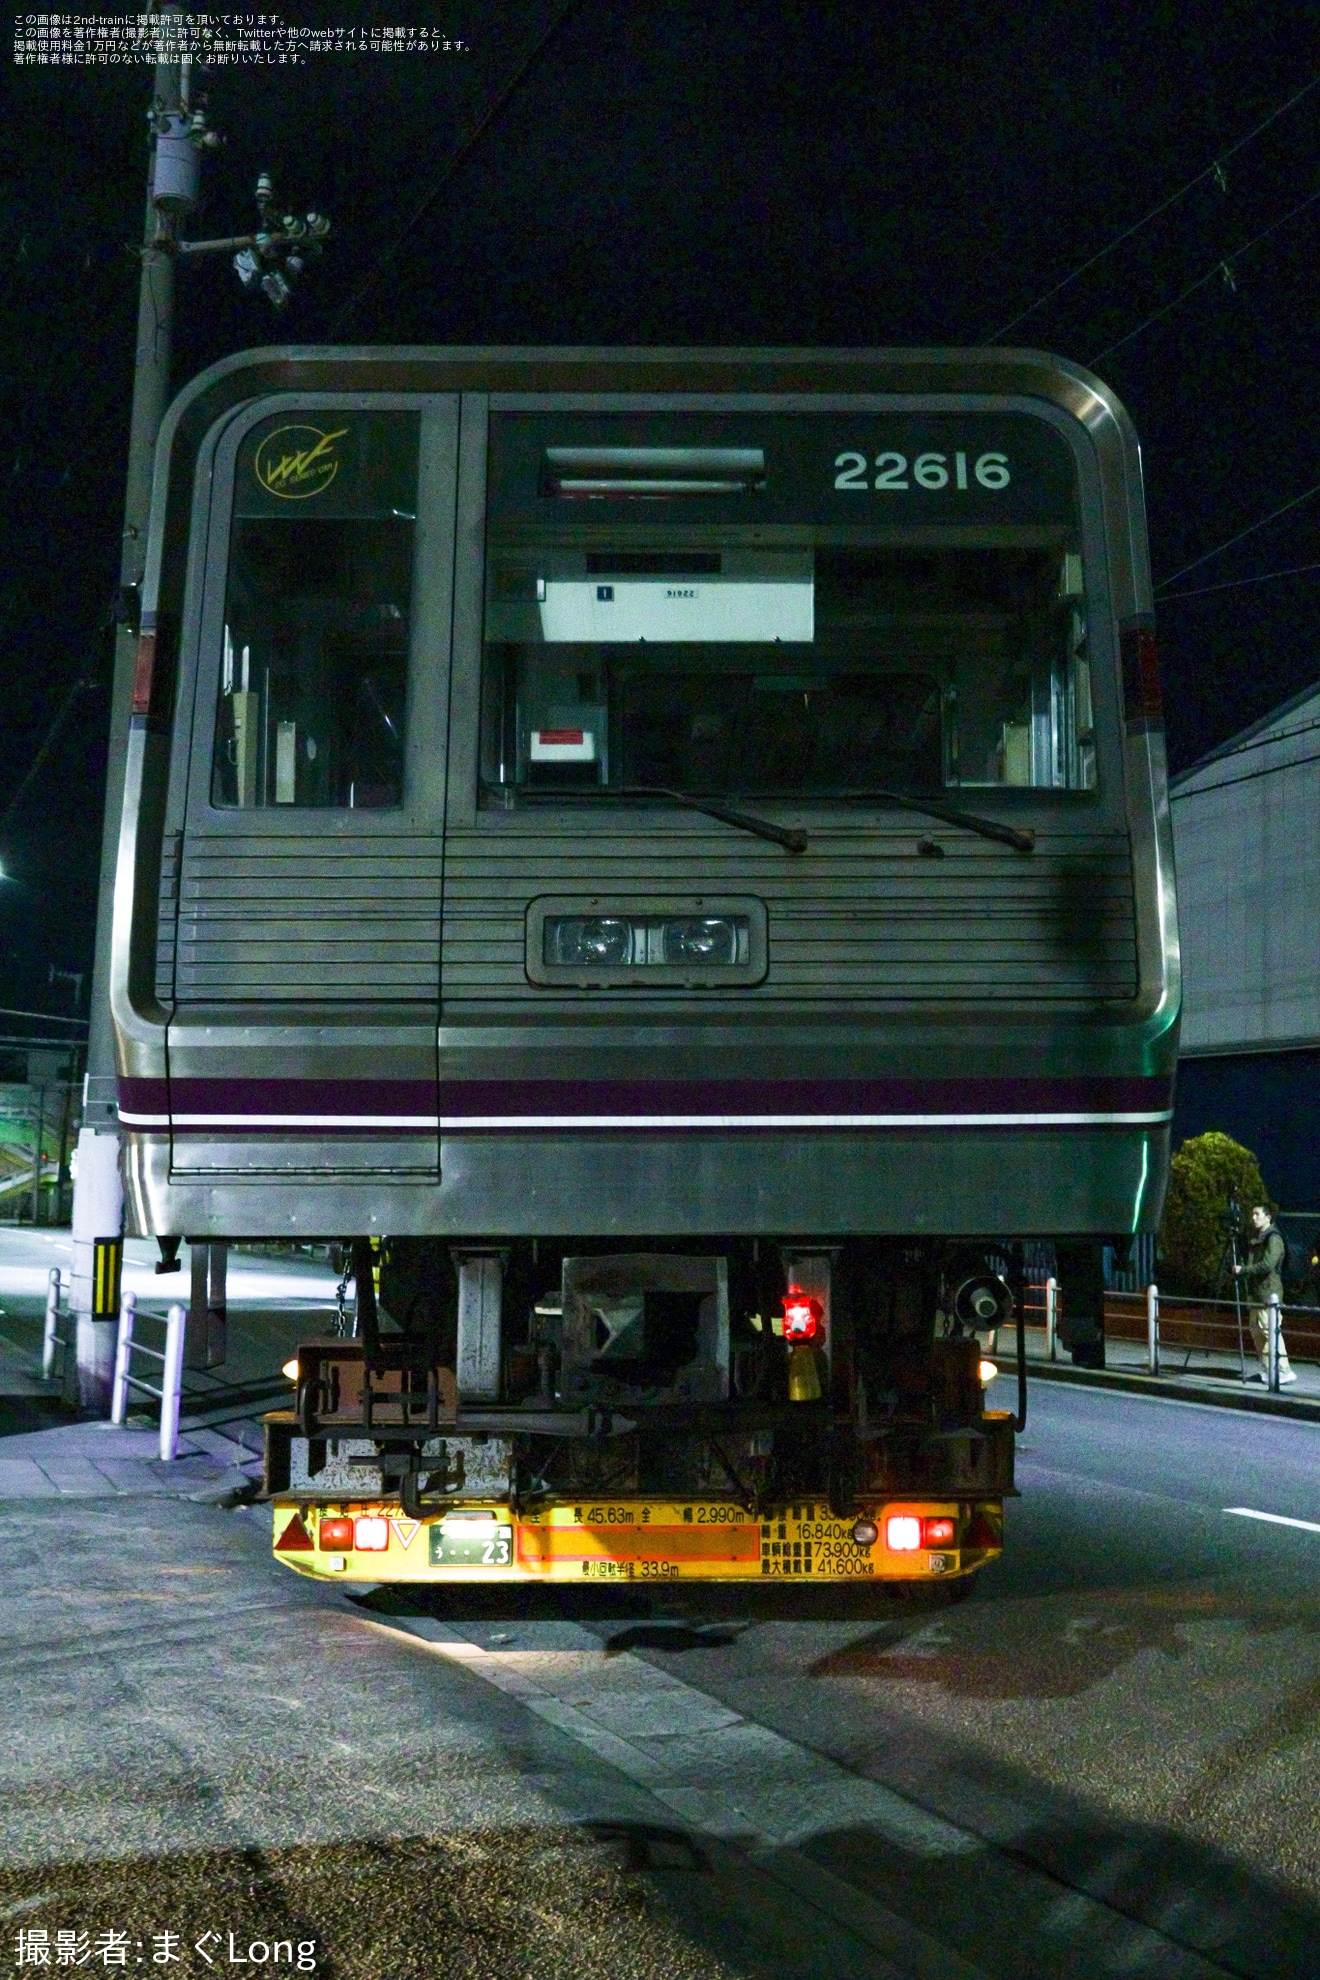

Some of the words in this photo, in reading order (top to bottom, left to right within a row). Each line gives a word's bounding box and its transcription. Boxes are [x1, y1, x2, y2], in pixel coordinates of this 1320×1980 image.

[834, 452, 1011, 490] 22616
[587, 1507, 634, 1523] 45.63m
[697, 1507, 744, 1523] 2.990m
[640, 1560, 680, 1577] 33.9m
